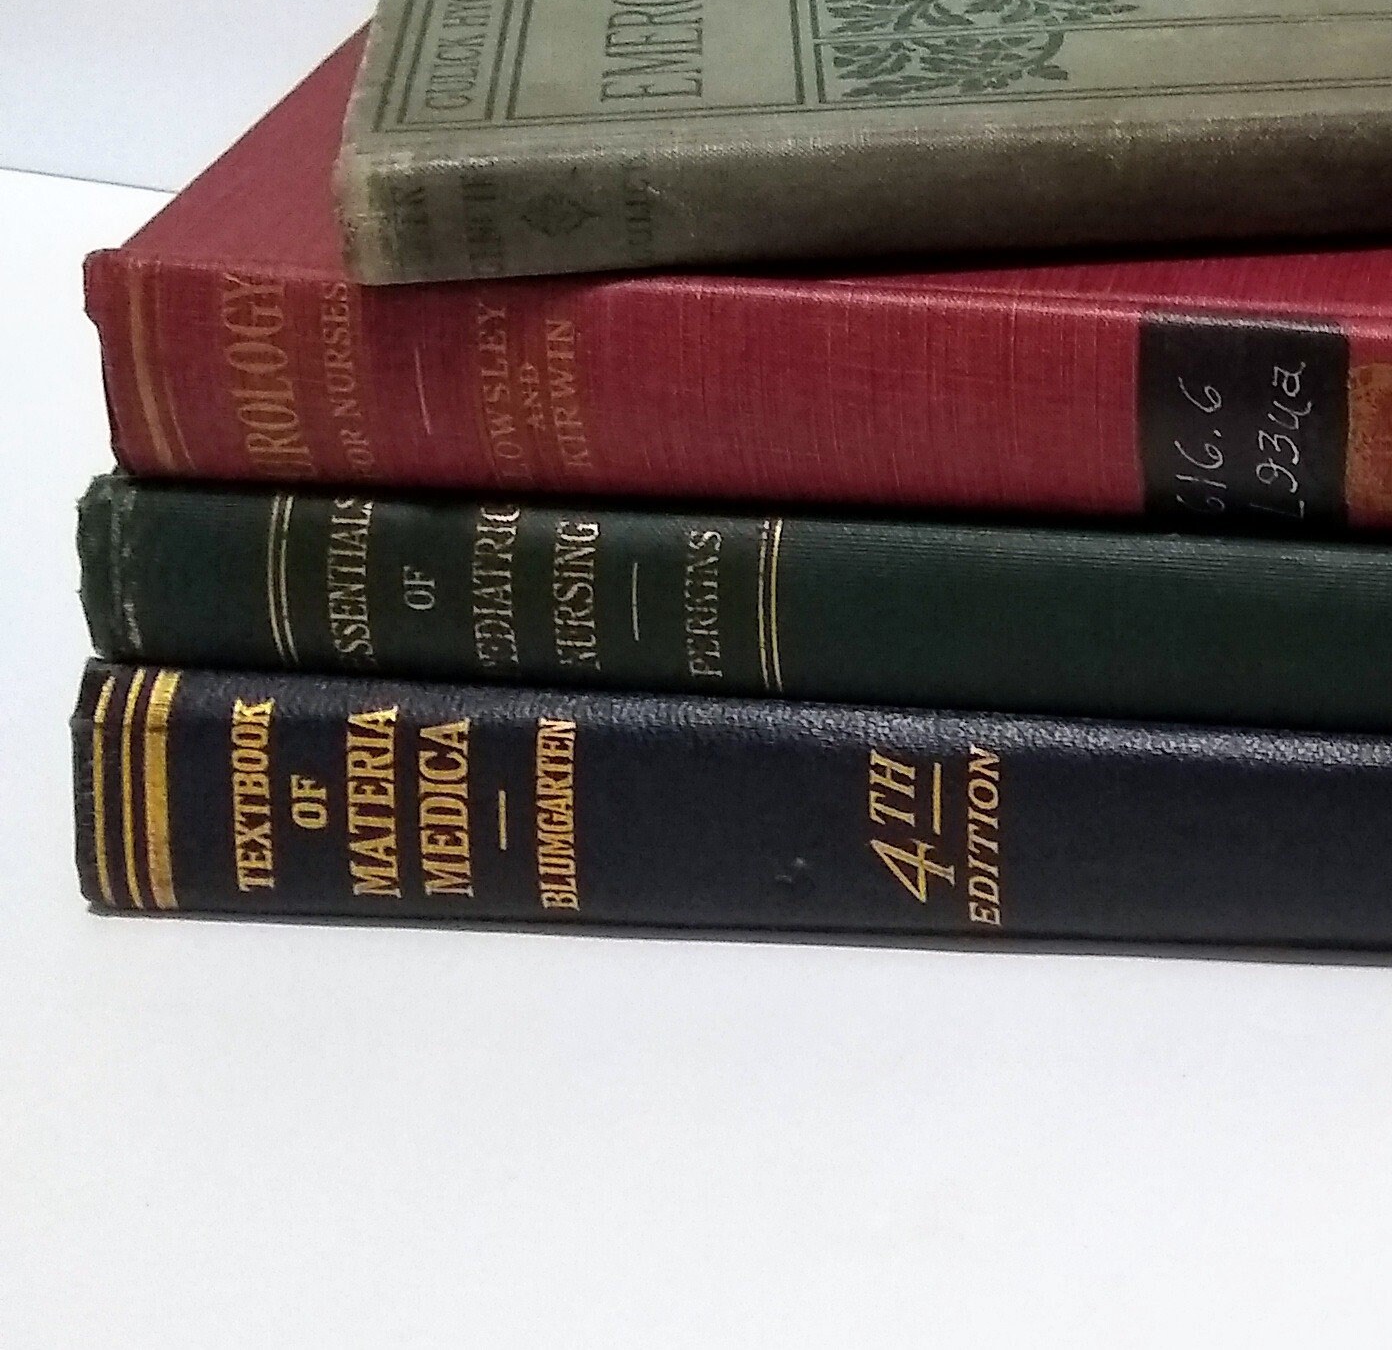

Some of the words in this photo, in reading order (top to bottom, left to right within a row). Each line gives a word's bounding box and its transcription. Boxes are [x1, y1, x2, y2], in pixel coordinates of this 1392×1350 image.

[425, 32, 487, 110] GULICK
[222, 271, 318, 478] UROLOGY
[321, 281, 366, 418] NURSES
[476, 298, 533, 482] LOWSLEY
[519, 361, 547, 431] AND
[545, 318, 593, 469] KIRWIN
[403, 565, 437, 612] OF
[472, 503, 522, 667] EDIATRIC
[685, 529, 733, 678] PERKINS
[231, 697, 276, 893] TEXTBOOK
[290, 774, 329, 830] OF
[346, 705, 401, 898] MATERIA
[418, 717, 474, 898] MEDICA
[535, 716, 581, 912] BLUMGARTEN
[968, 740, 1002, 926] EDITION
